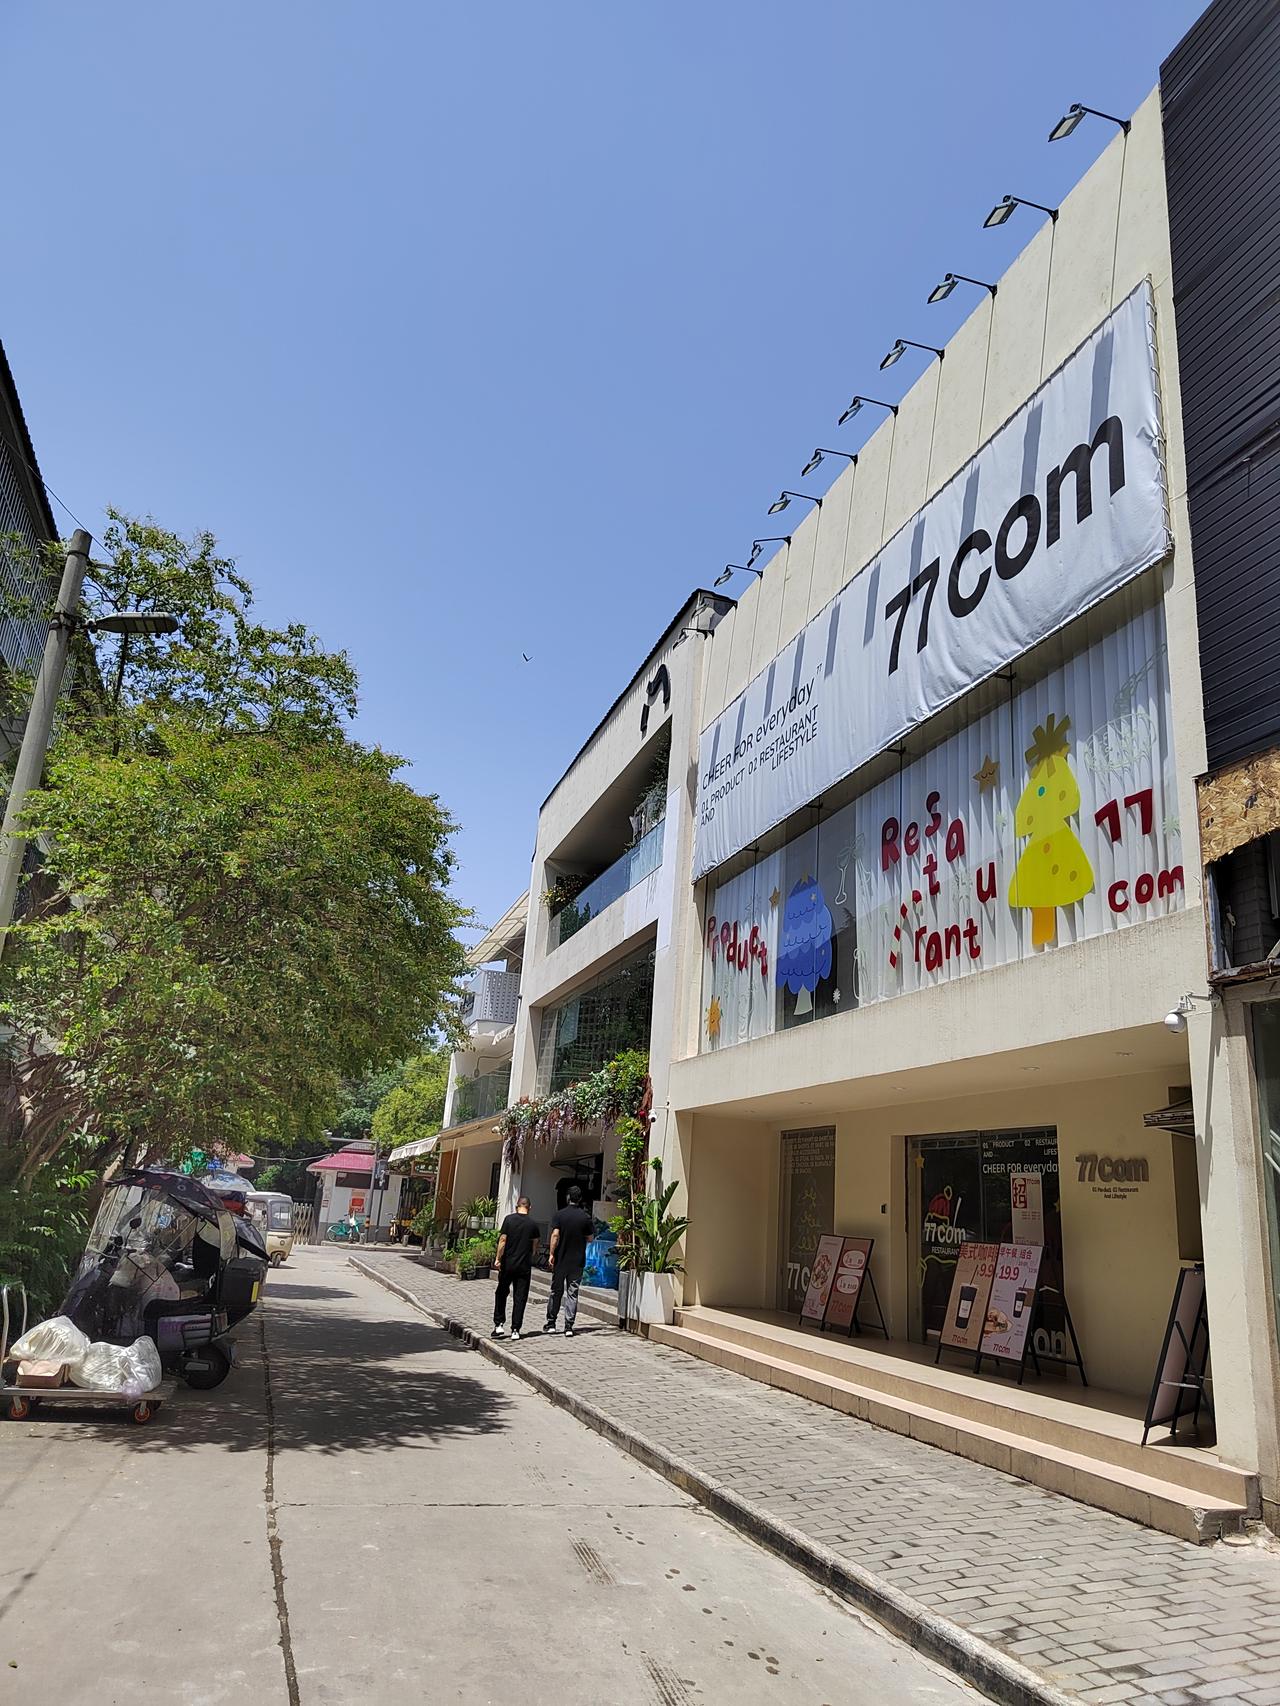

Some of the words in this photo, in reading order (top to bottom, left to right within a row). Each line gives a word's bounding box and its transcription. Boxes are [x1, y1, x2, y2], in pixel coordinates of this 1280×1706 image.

[701, 800, 709, 814] 01
[711, 767, 745, 804] PRODUCT
[748, 761, 758, 775] 02
[759, 704, 819, 766] RESTAURANT
[702, 753, 732, 790] CHEER
[733, 733, 754, 765] FOR
[756, 678, 815, 743] everyday
[700, 810, 716, 827] AND
[771, 722, 818, 771] LIFESTYLE
[1108, 865, 1185, 913] com
[707, 916, 768, 977] Product
[982, 1163, 1006, 1174] CHEER
[1007, 1163, 1022, 1173] FOR
[992, 1140, 1015, 1148] PRODUCT
